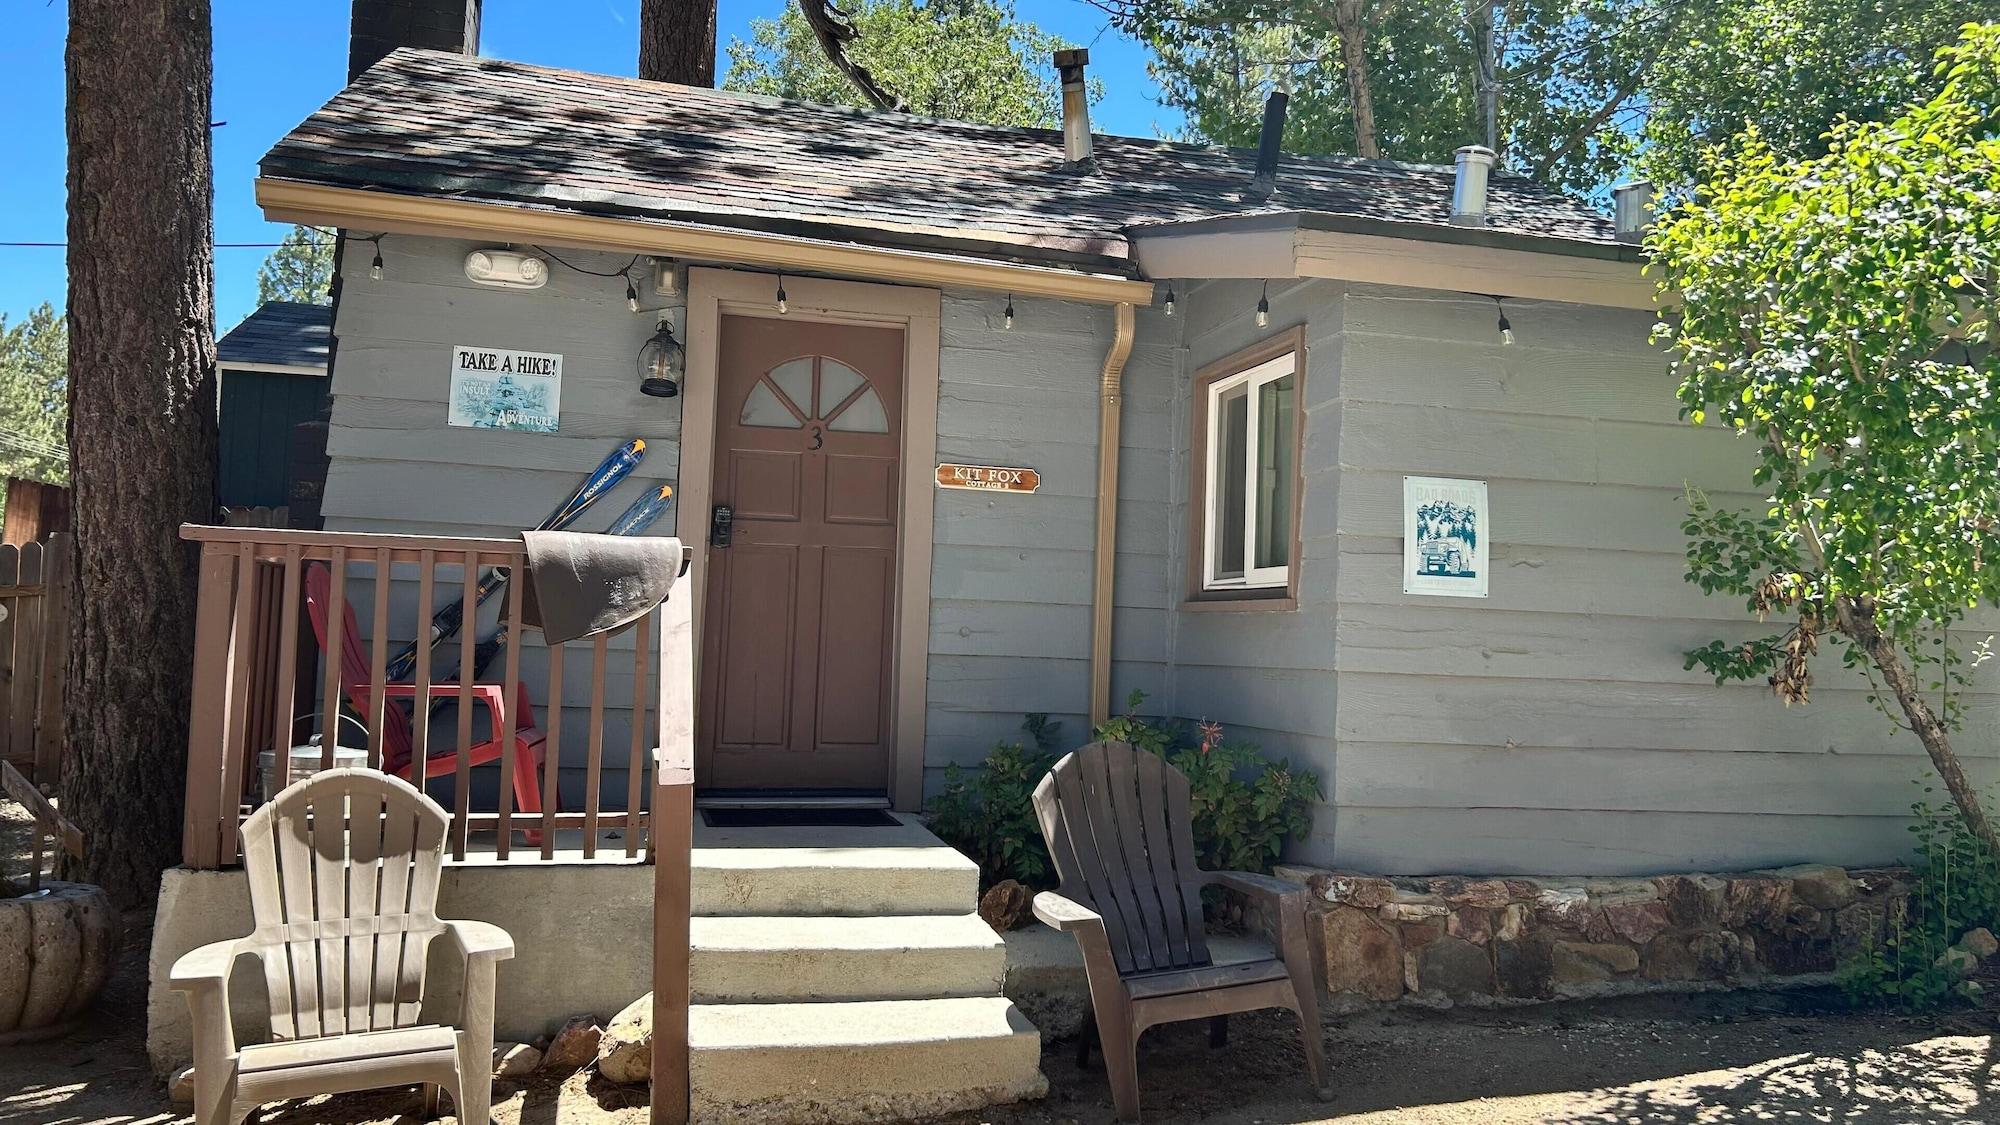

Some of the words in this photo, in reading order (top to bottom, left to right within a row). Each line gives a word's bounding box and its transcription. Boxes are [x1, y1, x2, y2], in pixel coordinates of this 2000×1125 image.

[459, 351, 497, 371] TAKE
[501, 355, 512, 372] A
[517, 356, 556, 375] HIKE!
[459, 384, 490, 395] INSULT
[495, 409, 553, 426] ADVENTURE
[808, 426, 823, 450] 3
[583, 462, 623, 500] ROSSIGNOL
[954, 467, 982, 480] KIT
[988, 469, 1022, 483] FOX
[965, 480, 1002, 489] COTTAGE
